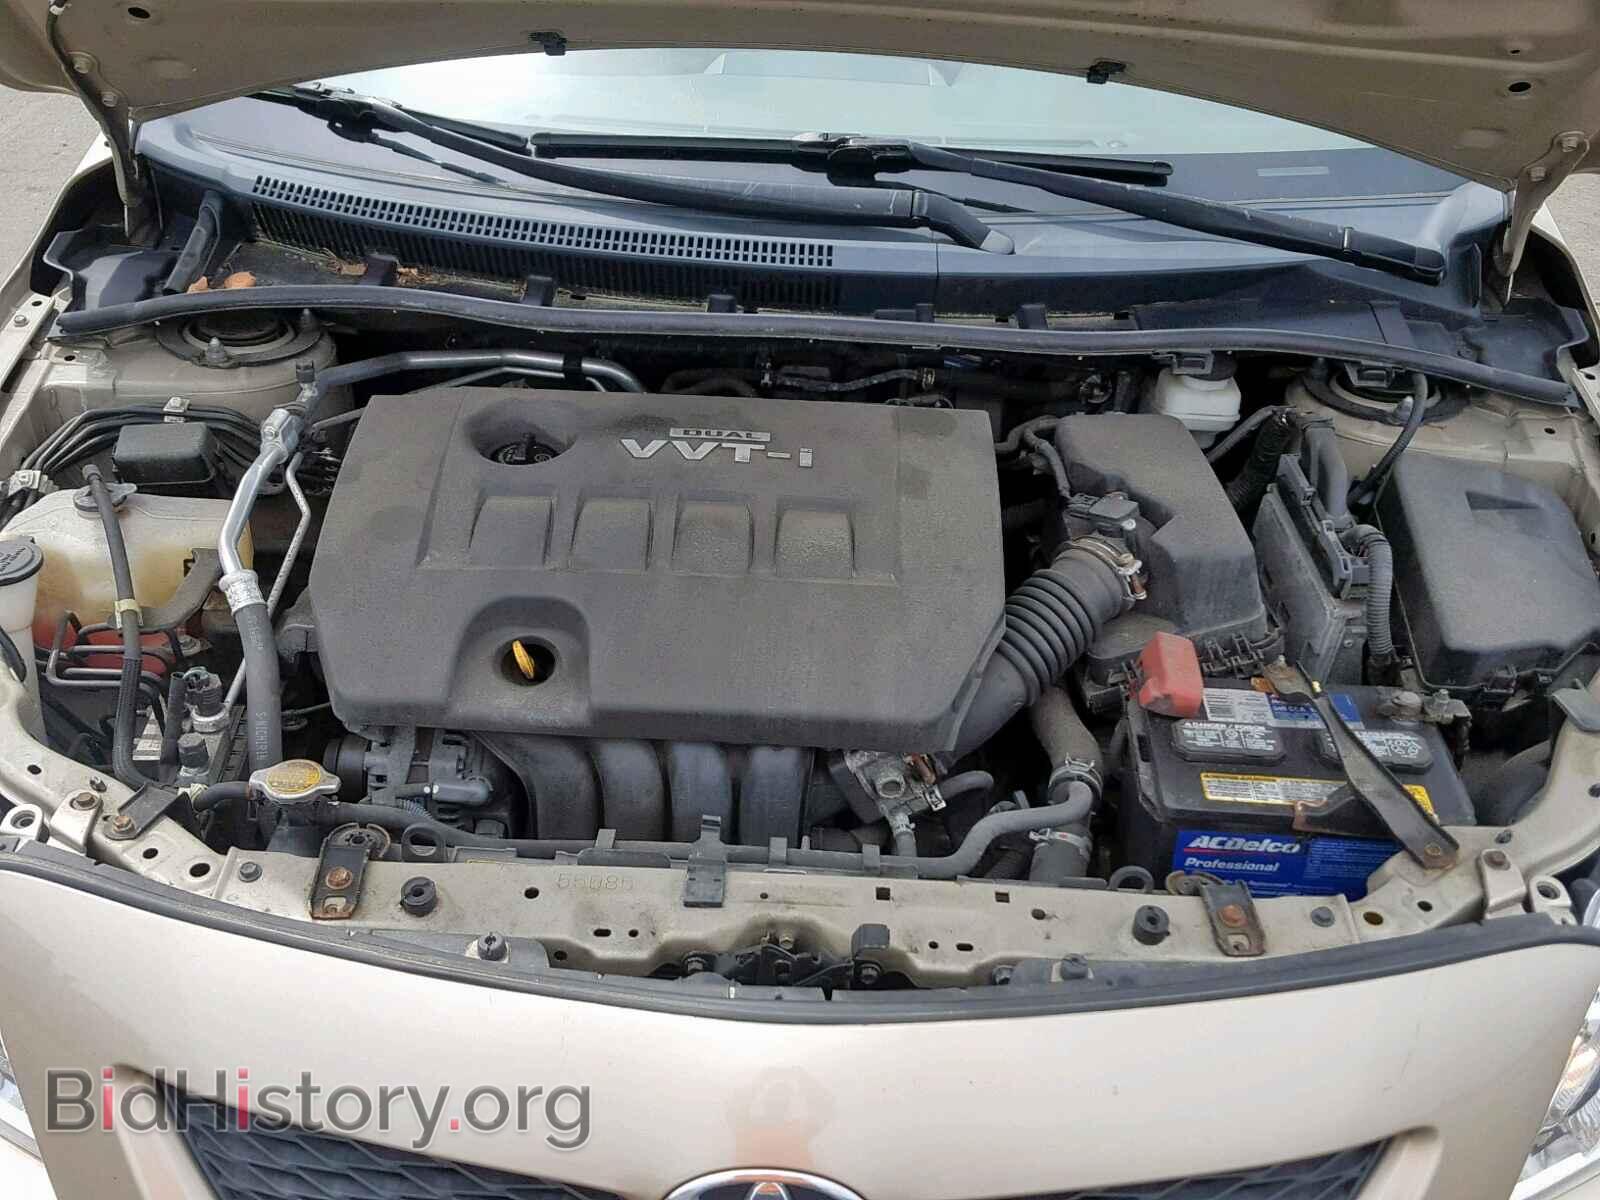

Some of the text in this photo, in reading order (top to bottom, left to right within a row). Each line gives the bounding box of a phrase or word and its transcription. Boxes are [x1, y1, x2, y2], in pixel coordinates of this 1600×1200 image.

[678, 428, 764, 441] DUAL
[619, 438, 813, 468] VVT-i
[1188, 835, 1301, 854] ACDelco
[1184, 857, 1281, 872] Professional
